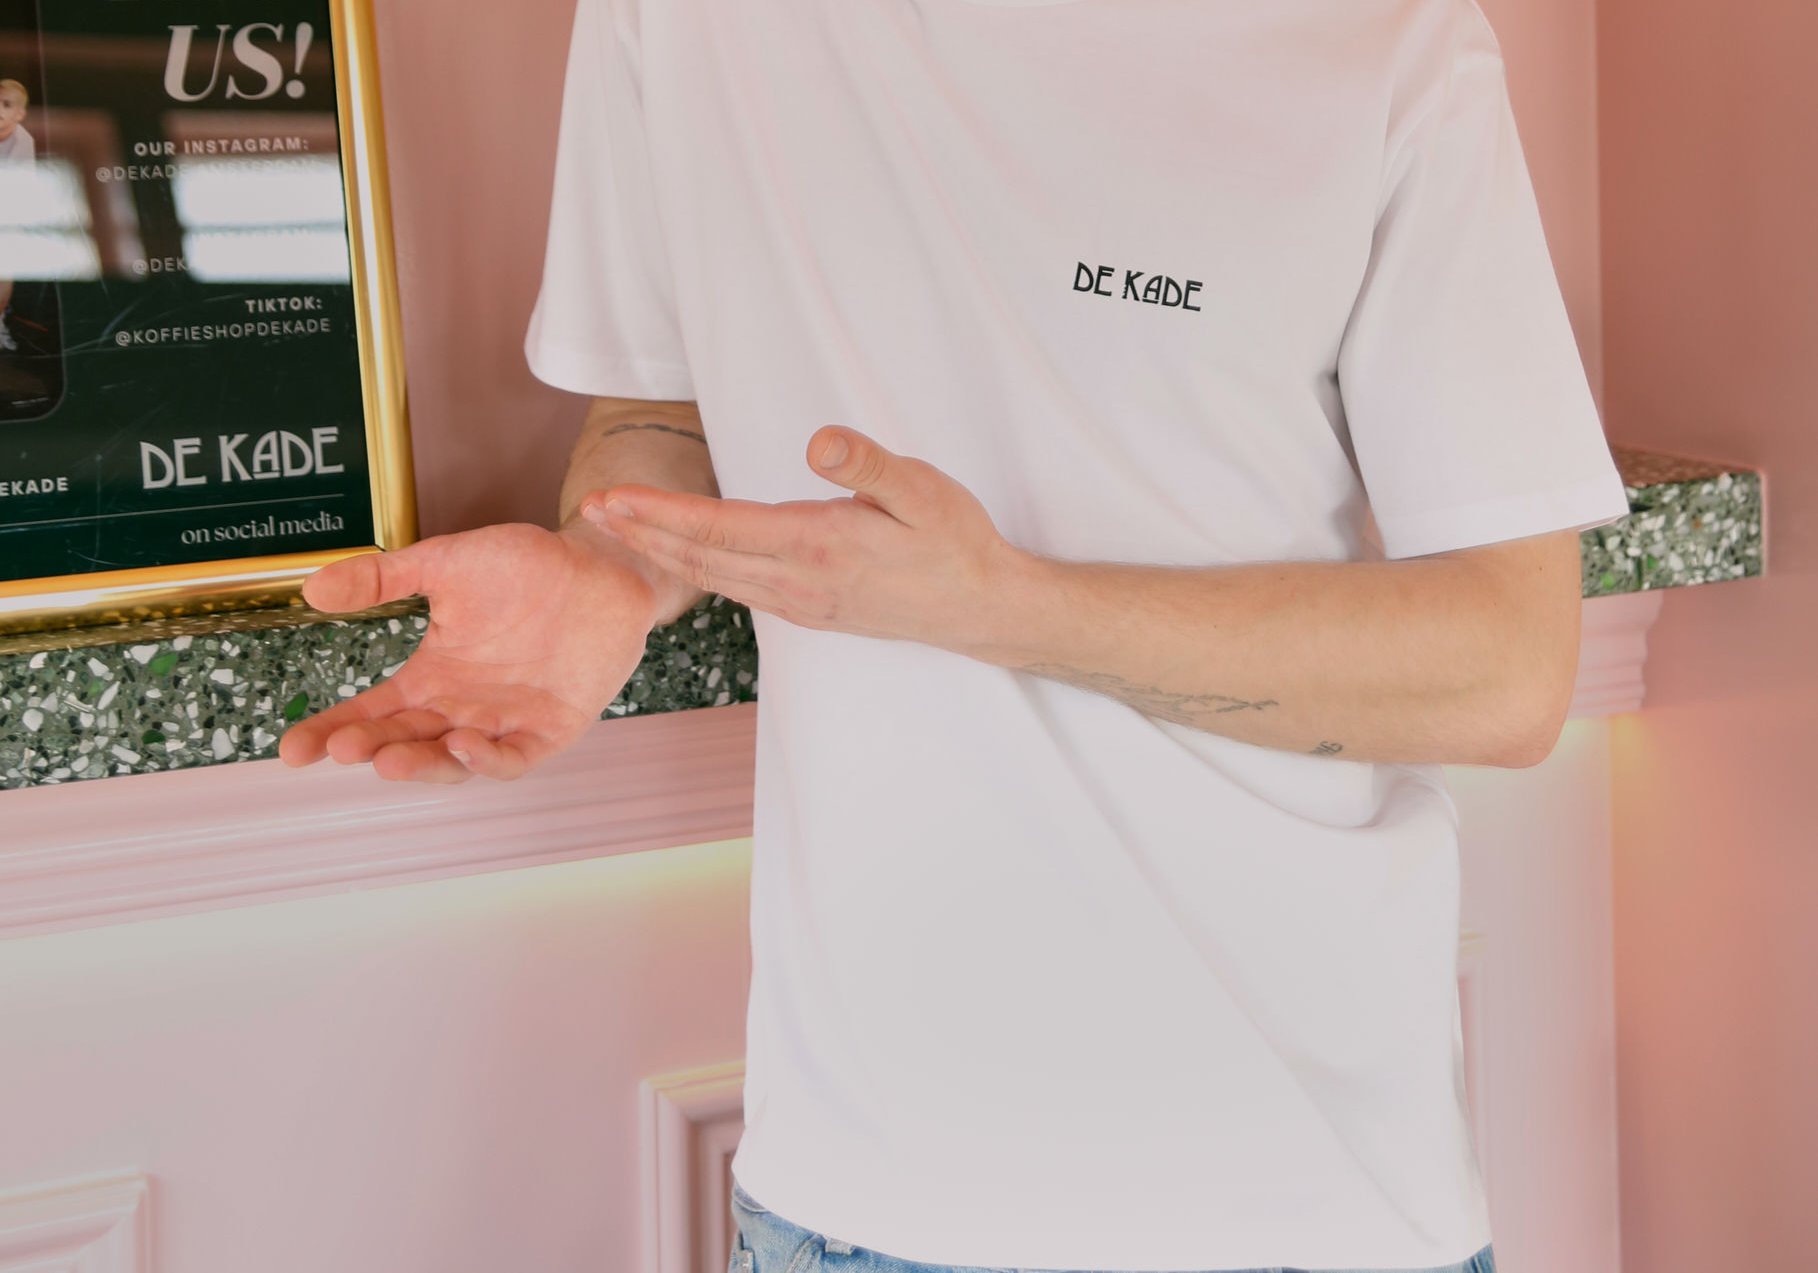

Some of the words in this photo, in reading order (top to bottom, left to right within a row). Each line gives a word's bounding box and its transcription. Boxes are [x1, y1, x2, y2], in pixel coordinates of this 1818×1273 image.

[164, 22, 313, 102] US!
[134, 141, 176, 157] OUR
[184, 136, 309, 154] INSTAGRAM:
[1073, 261, 1115, 297] DE
[1122, 270, 1203, 312] KADE
[245, 296, 322, 314] TIKTOK:
[115, 317, 330, 346] @KOFFIESHOPDEKADE
[139, 437, 207, 490] DE
[219, 426, 345, 483] KADE
[0, 476, 69, 497] EKADE
[180, 528, 211, 545] on
[214, 515, 276, 542] social
[279, 510, 344, 536] media
